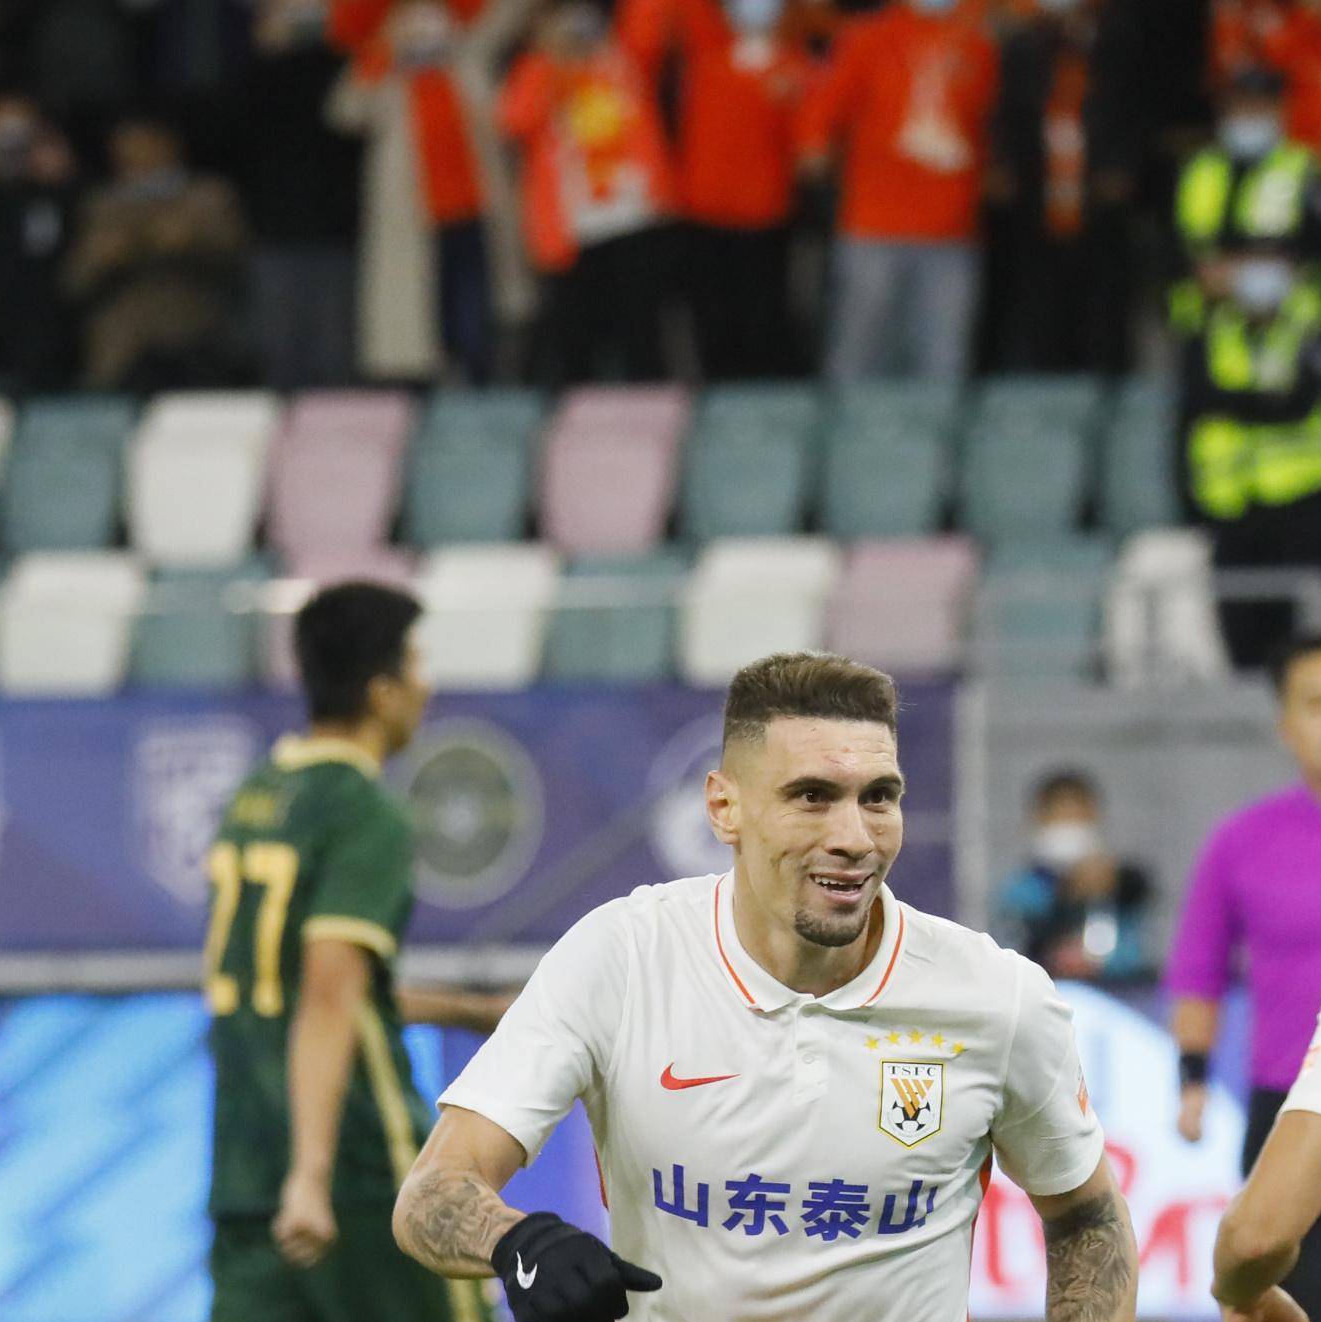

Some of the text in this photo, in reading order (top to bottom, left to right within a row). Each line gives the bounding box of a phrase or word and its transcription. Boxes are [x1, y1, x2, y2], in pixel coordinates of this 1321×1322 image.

[887, 1065, 937, 1077] TSFC
[652, 1164, 937, 1241] 山东泰山
